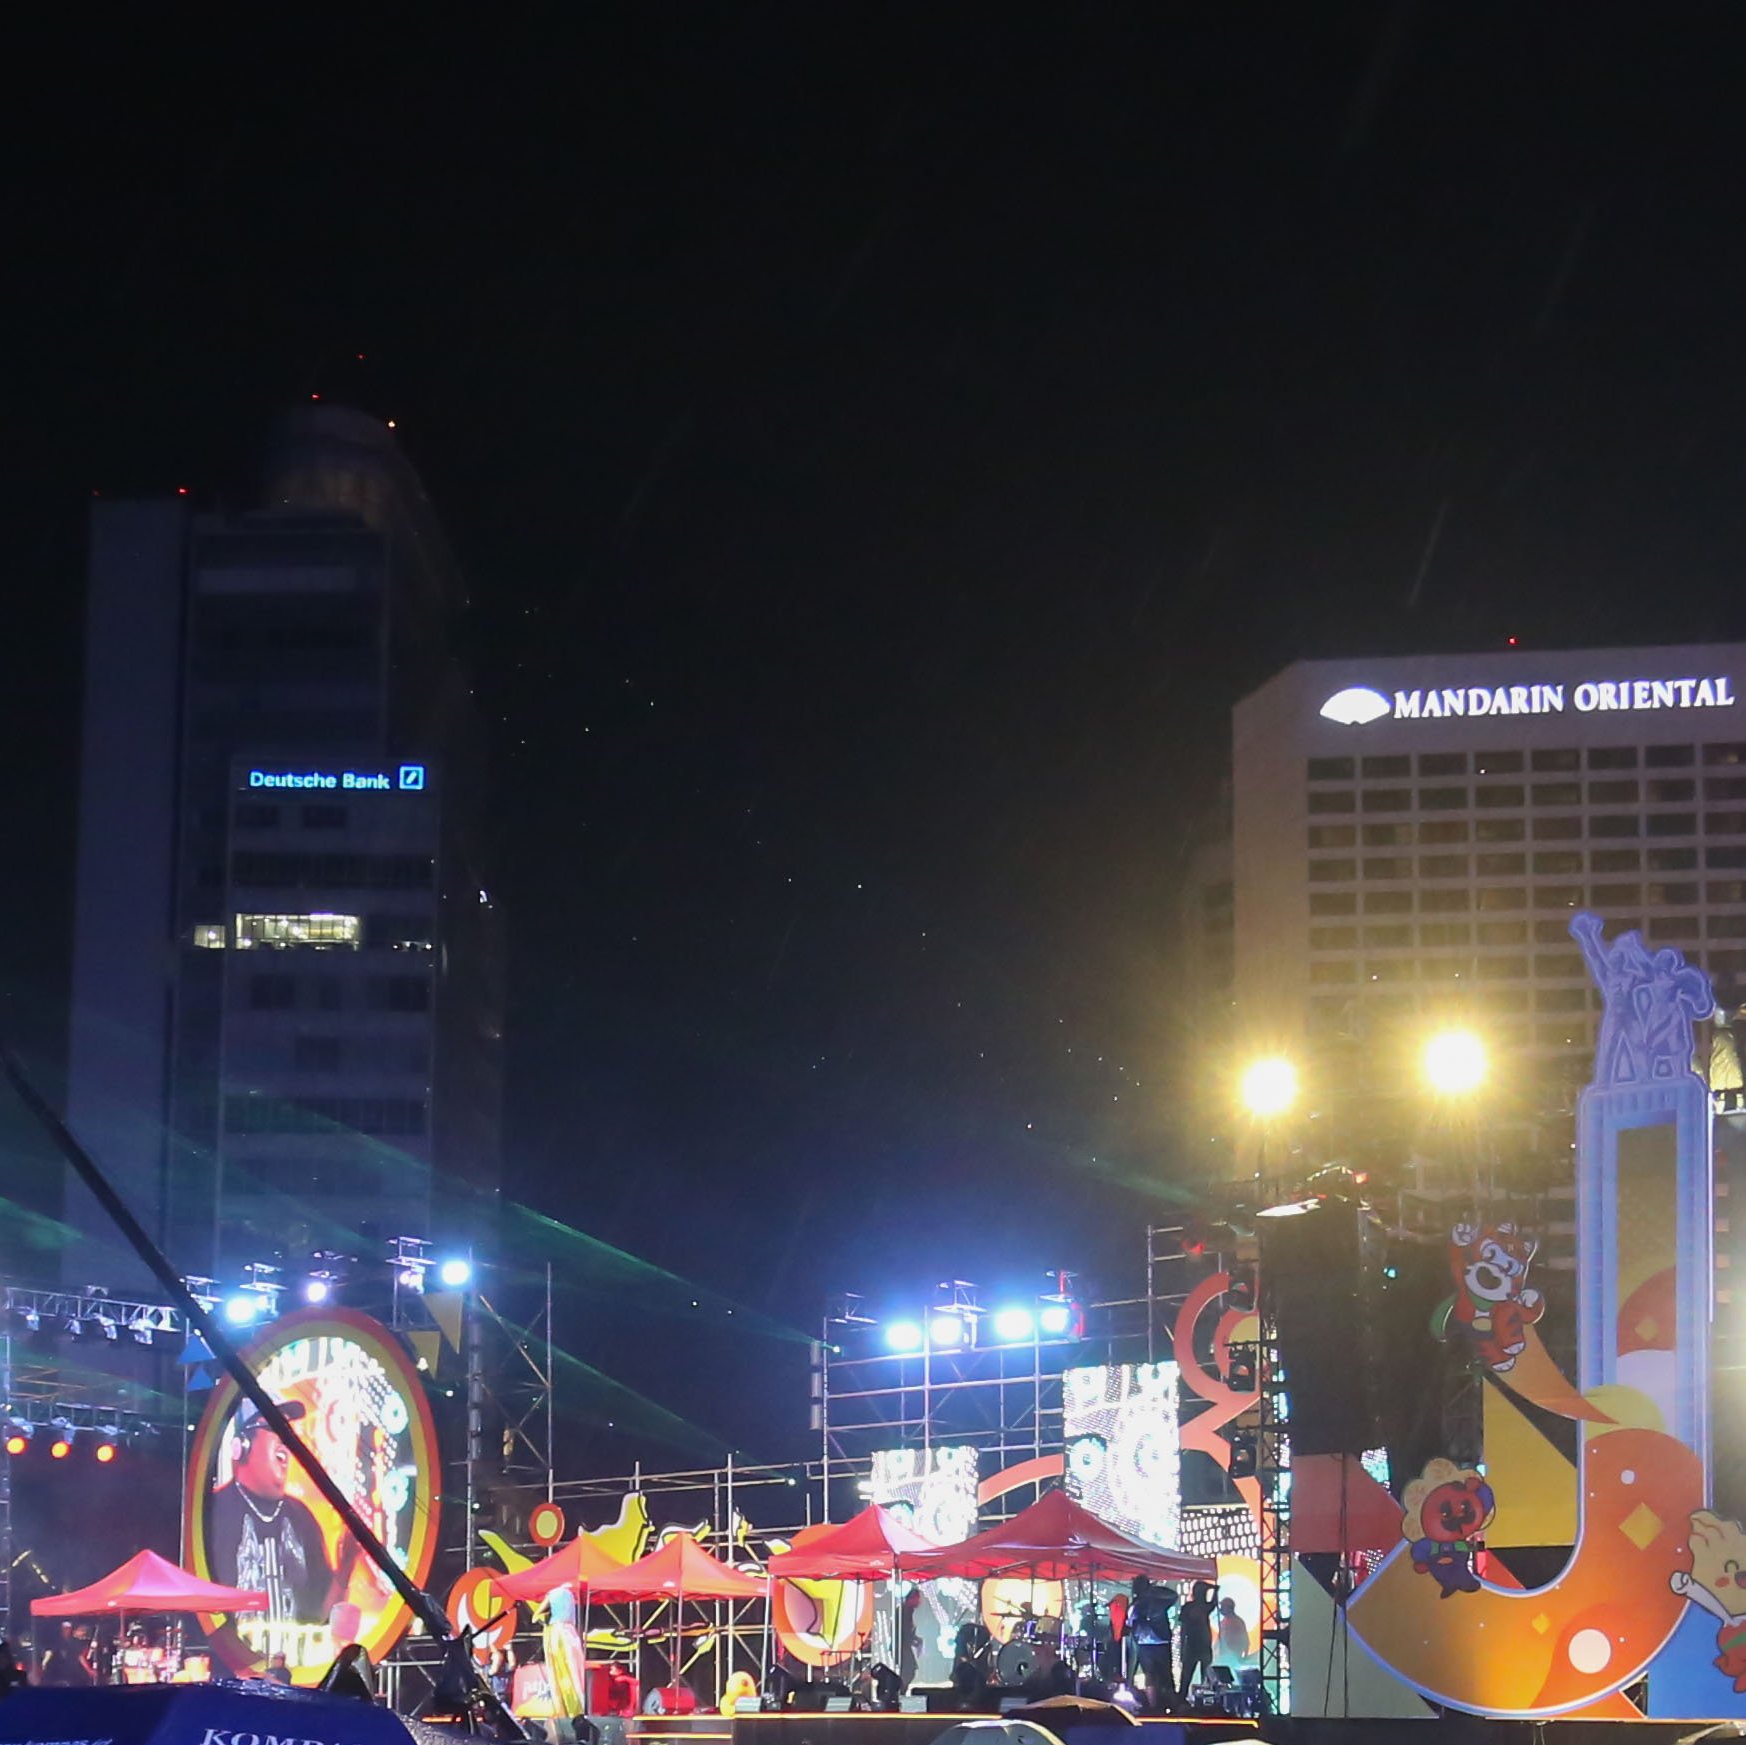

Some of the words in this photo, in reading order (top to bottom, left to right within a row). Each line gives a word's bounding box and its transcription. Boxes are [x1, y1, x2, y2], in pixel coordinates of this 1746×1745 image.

[1393, 684, 1564, 719] MANDARIN
[1574, 677, 1736, 712] ORIENTAL
[249, 771, 337, 789] Deutsche
[342, 772, 391, 790] Bank
